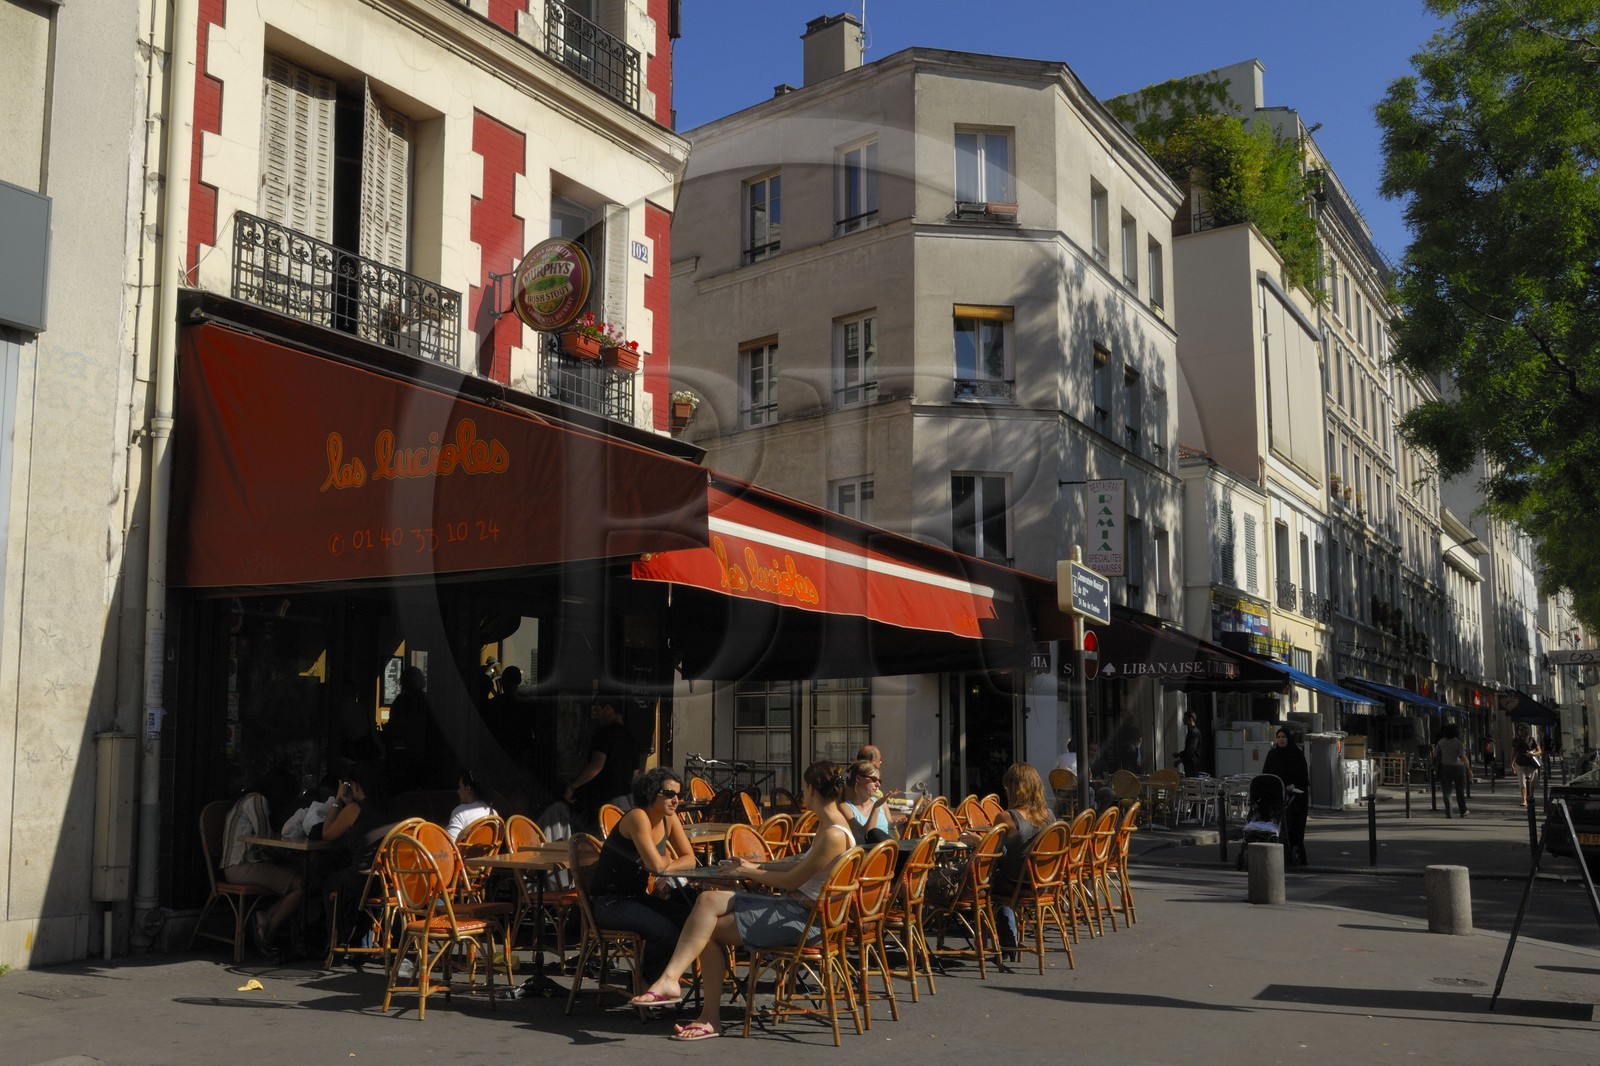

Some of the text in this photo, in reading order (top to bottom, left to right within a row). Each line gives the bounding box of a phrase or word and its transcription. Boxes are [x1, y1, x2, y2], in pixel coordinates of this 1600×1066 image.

[545, 244, 574, 259] QUALITY
[632, 241, 648, 262] 102
[527, 285, 570, 303] IRISH STOUT
[320, 418, 509, 492] les lucioles
[353, 530, 374, 549] 01
[381, 528, 402, 549] 40
[446, 522, 468, 543] 10
[476, 519, 500, 541] 24
[714, 536, 819, 604] les lucioles
